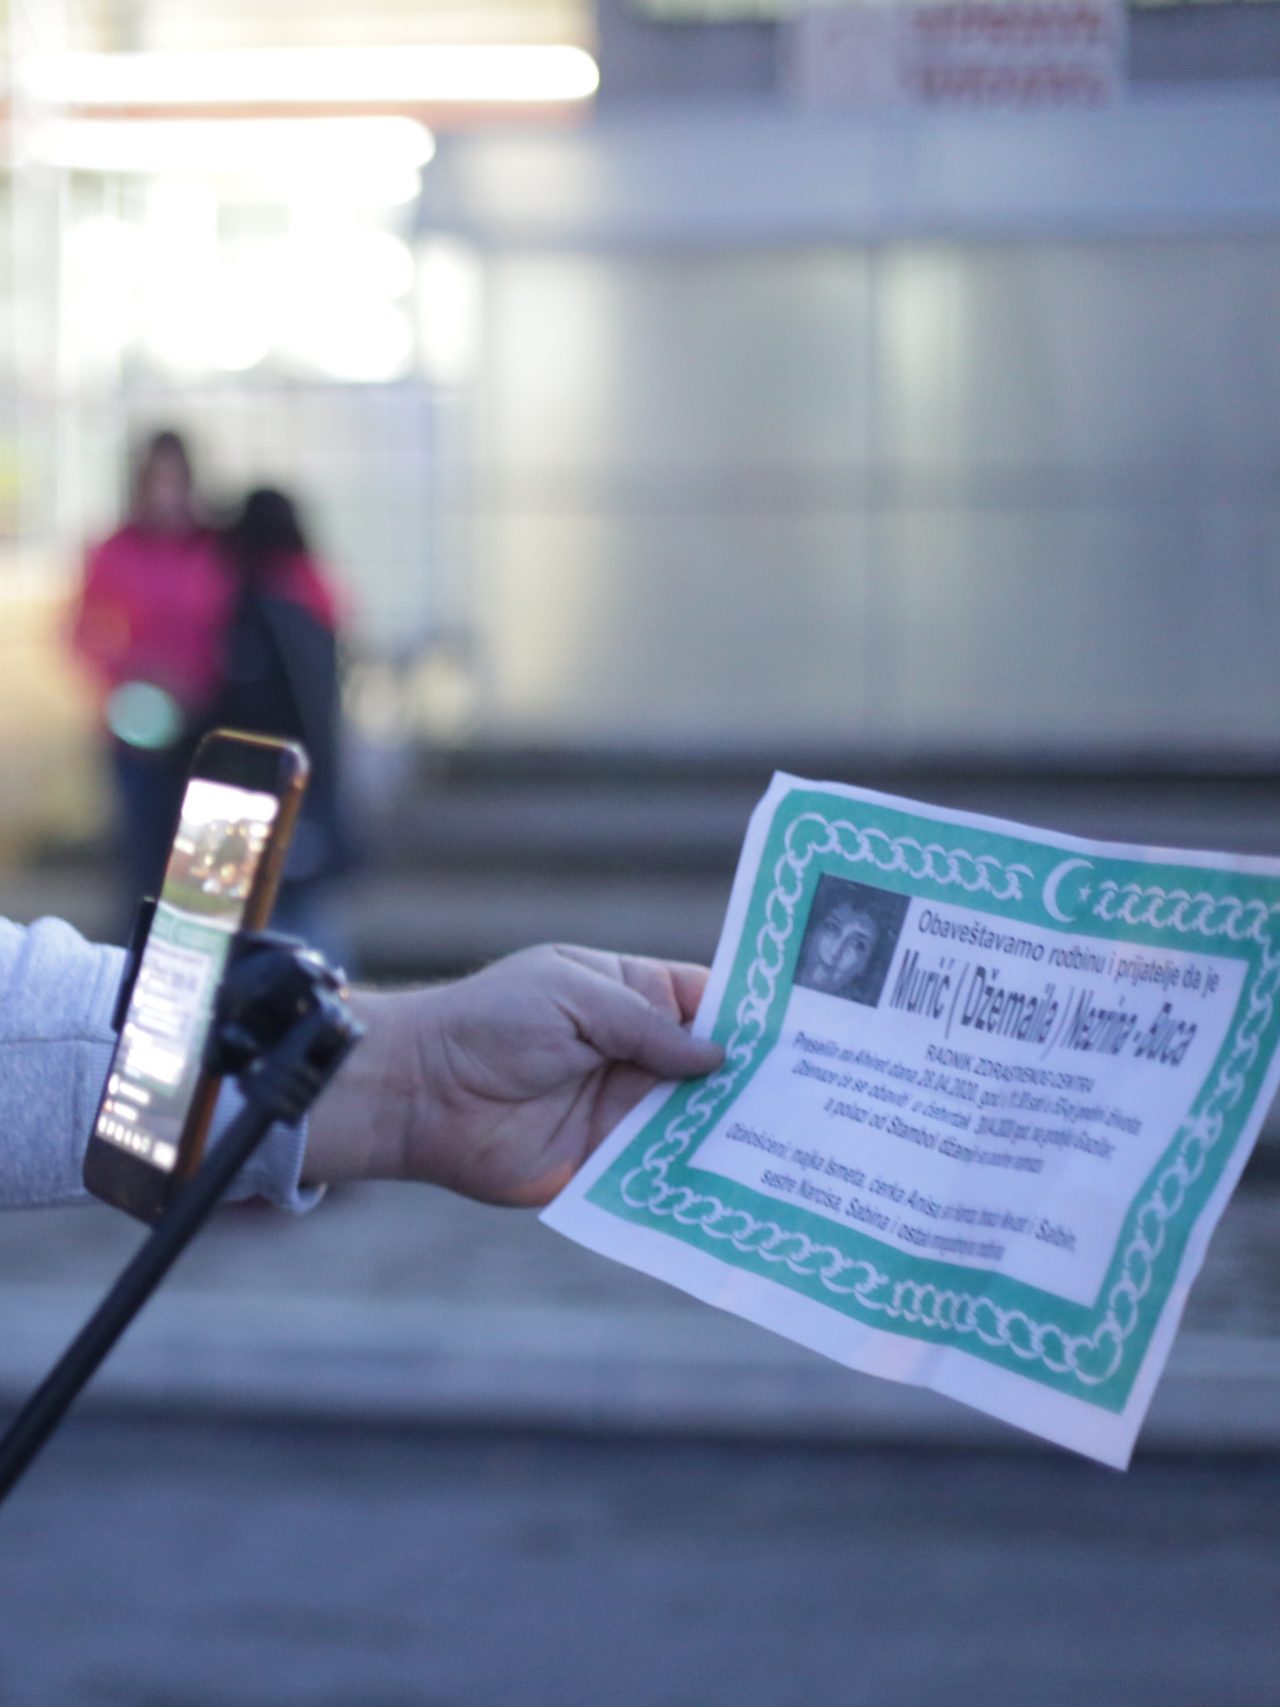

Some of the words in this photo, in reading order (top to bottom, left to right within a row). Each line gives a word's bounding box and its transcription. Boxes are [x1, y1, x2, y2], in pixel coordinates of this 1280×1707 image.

[918, 909, 1045, 961] Obaveštavamo
[1048, 944, 1105, 974] rodbinu
[1114, 953, 1179, 992] prijatelje
[1182, 962, 1201, 990] da
[1200, 965, 1219, 998] je
[889, 948, 955, 1019] Murić
[926, 1043, 973, 1072] RADNIK
[886, 1115, 941, 1150] Stambol
